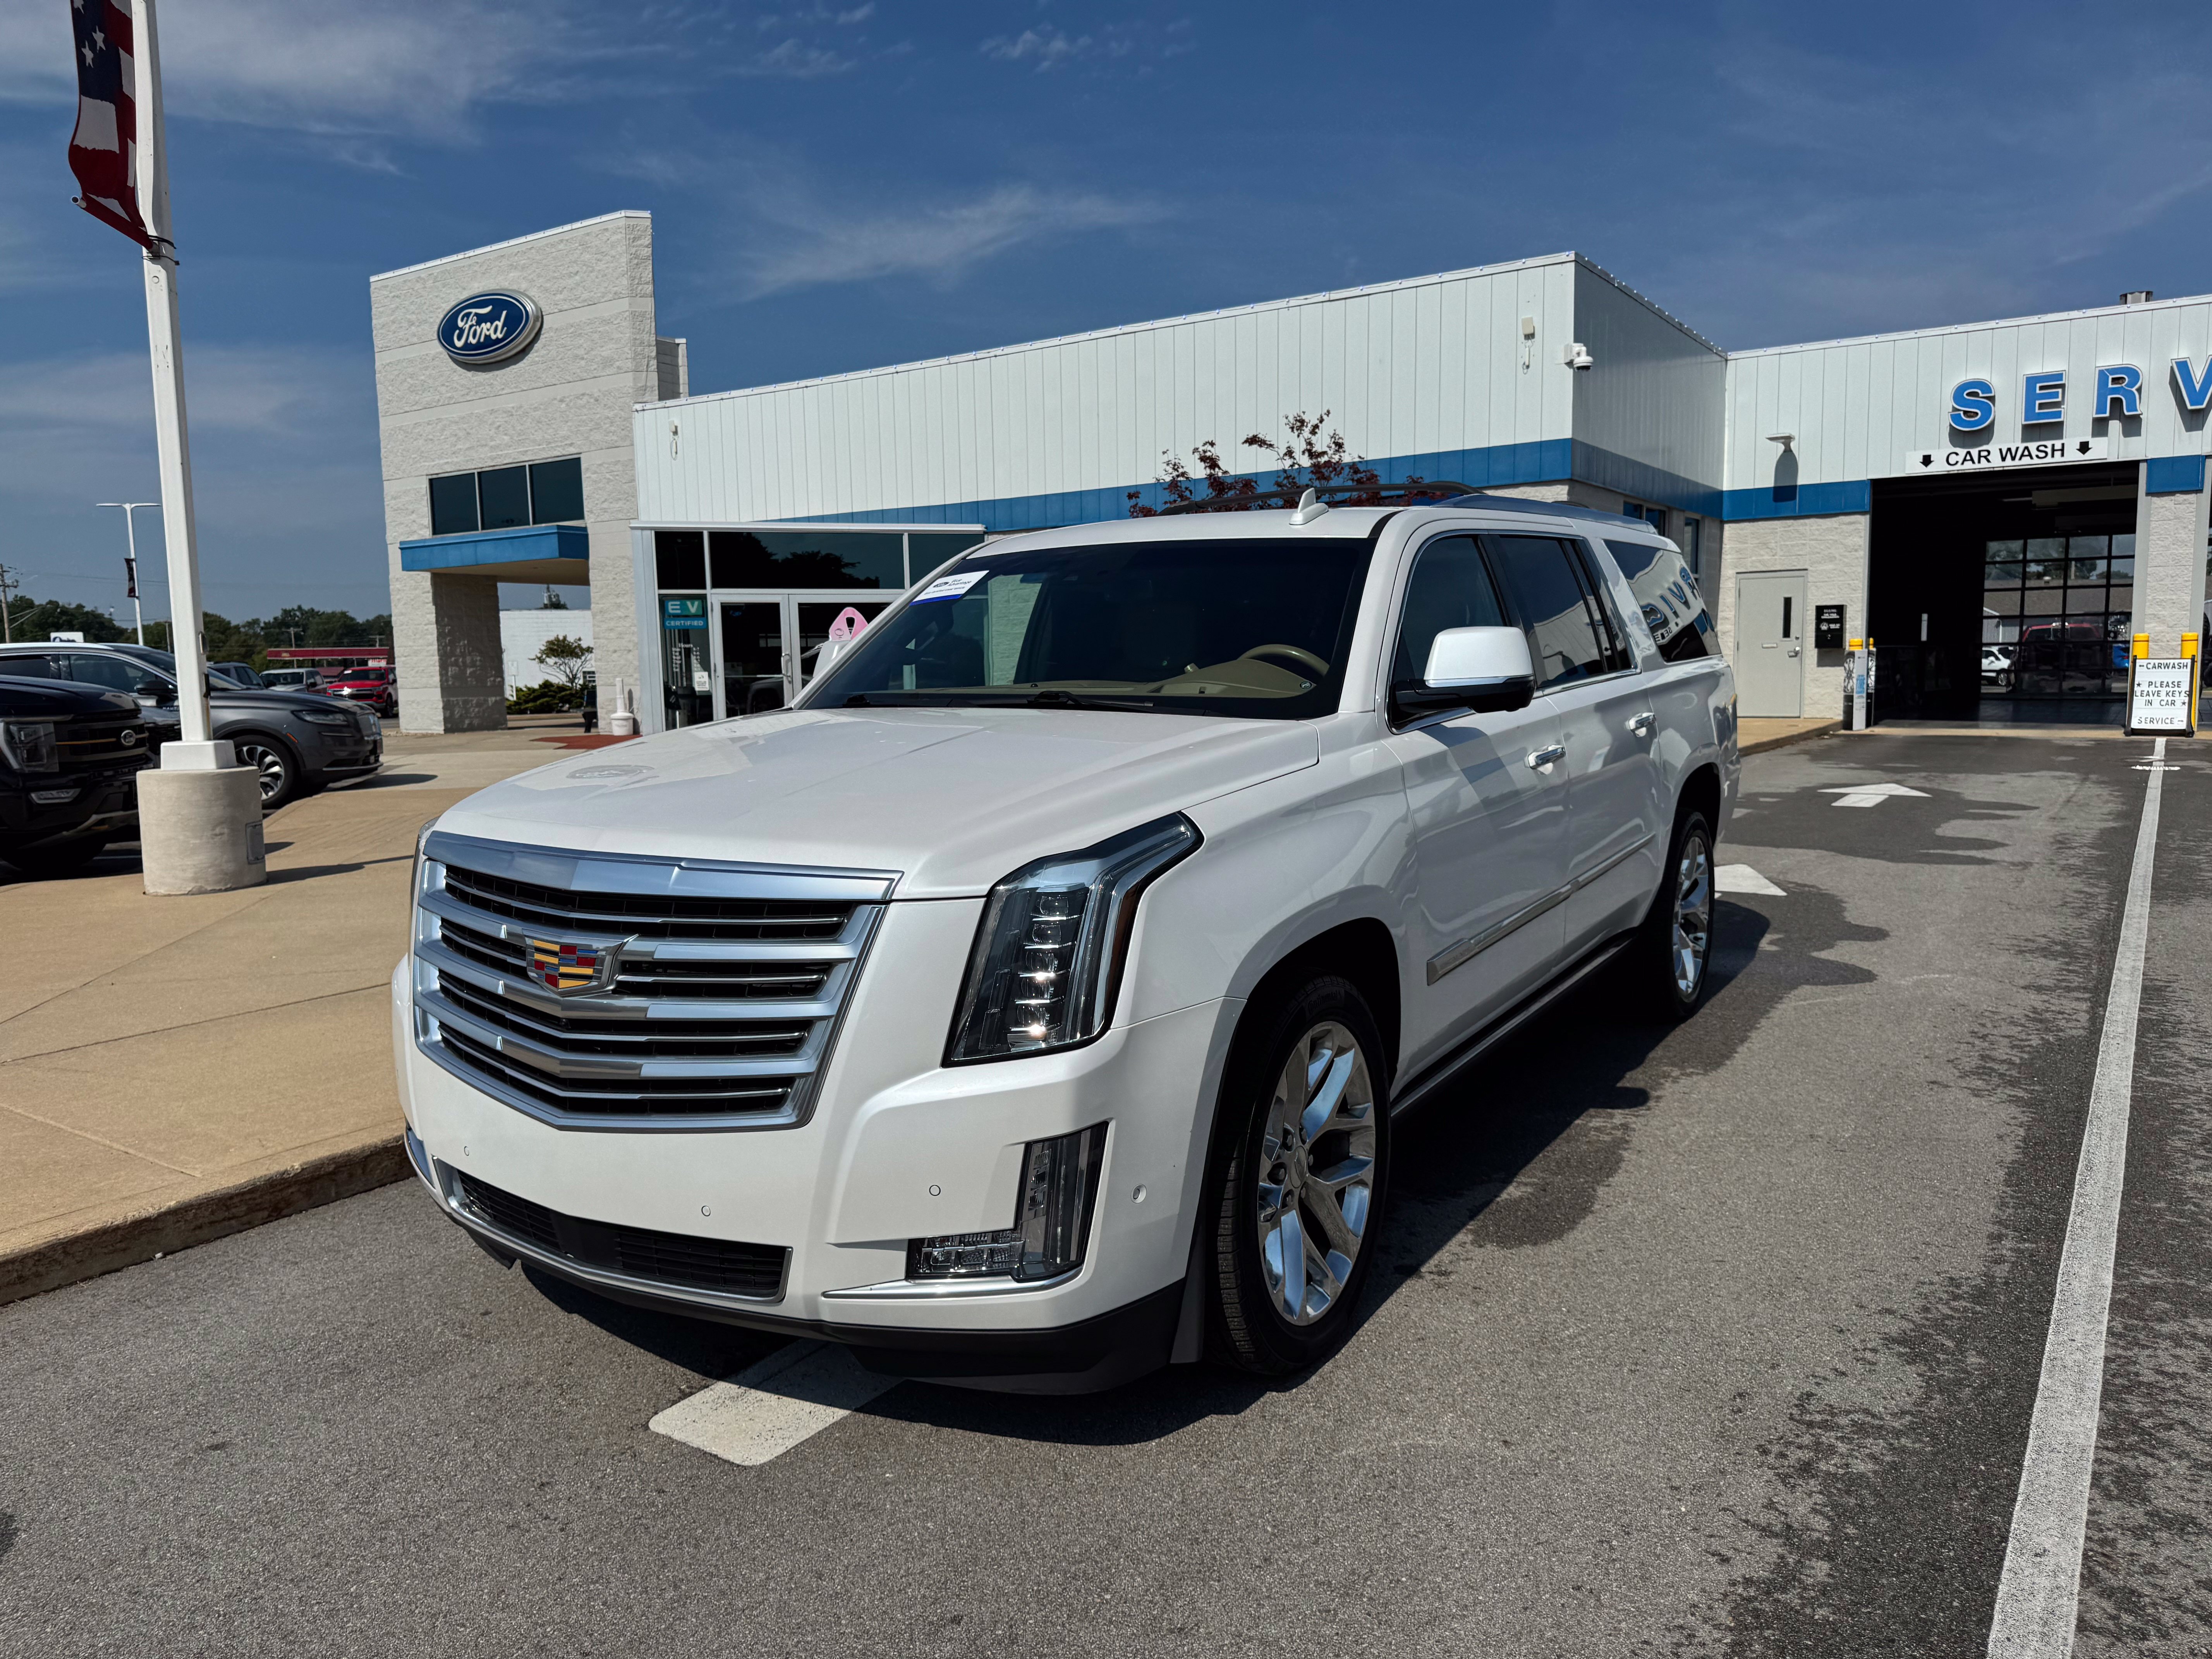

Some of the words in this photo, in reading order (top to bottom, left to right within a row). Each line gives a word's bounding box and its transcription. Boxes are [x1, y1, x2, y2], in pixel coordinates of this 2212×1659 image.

[454, 305, 507, 348] Ford
[1948, 354, 2212, 431] SERV
[1945, 449, 1992, 466] CAR
[1998, 442, 2065, 462] WASH
[668, 601, 699, 613] EV
[2146, 662, 2188, 670] CARWASH
[2148, 680, 2182, 689] PLEASE
[2137, 716, 2175, 725] SERVICE
